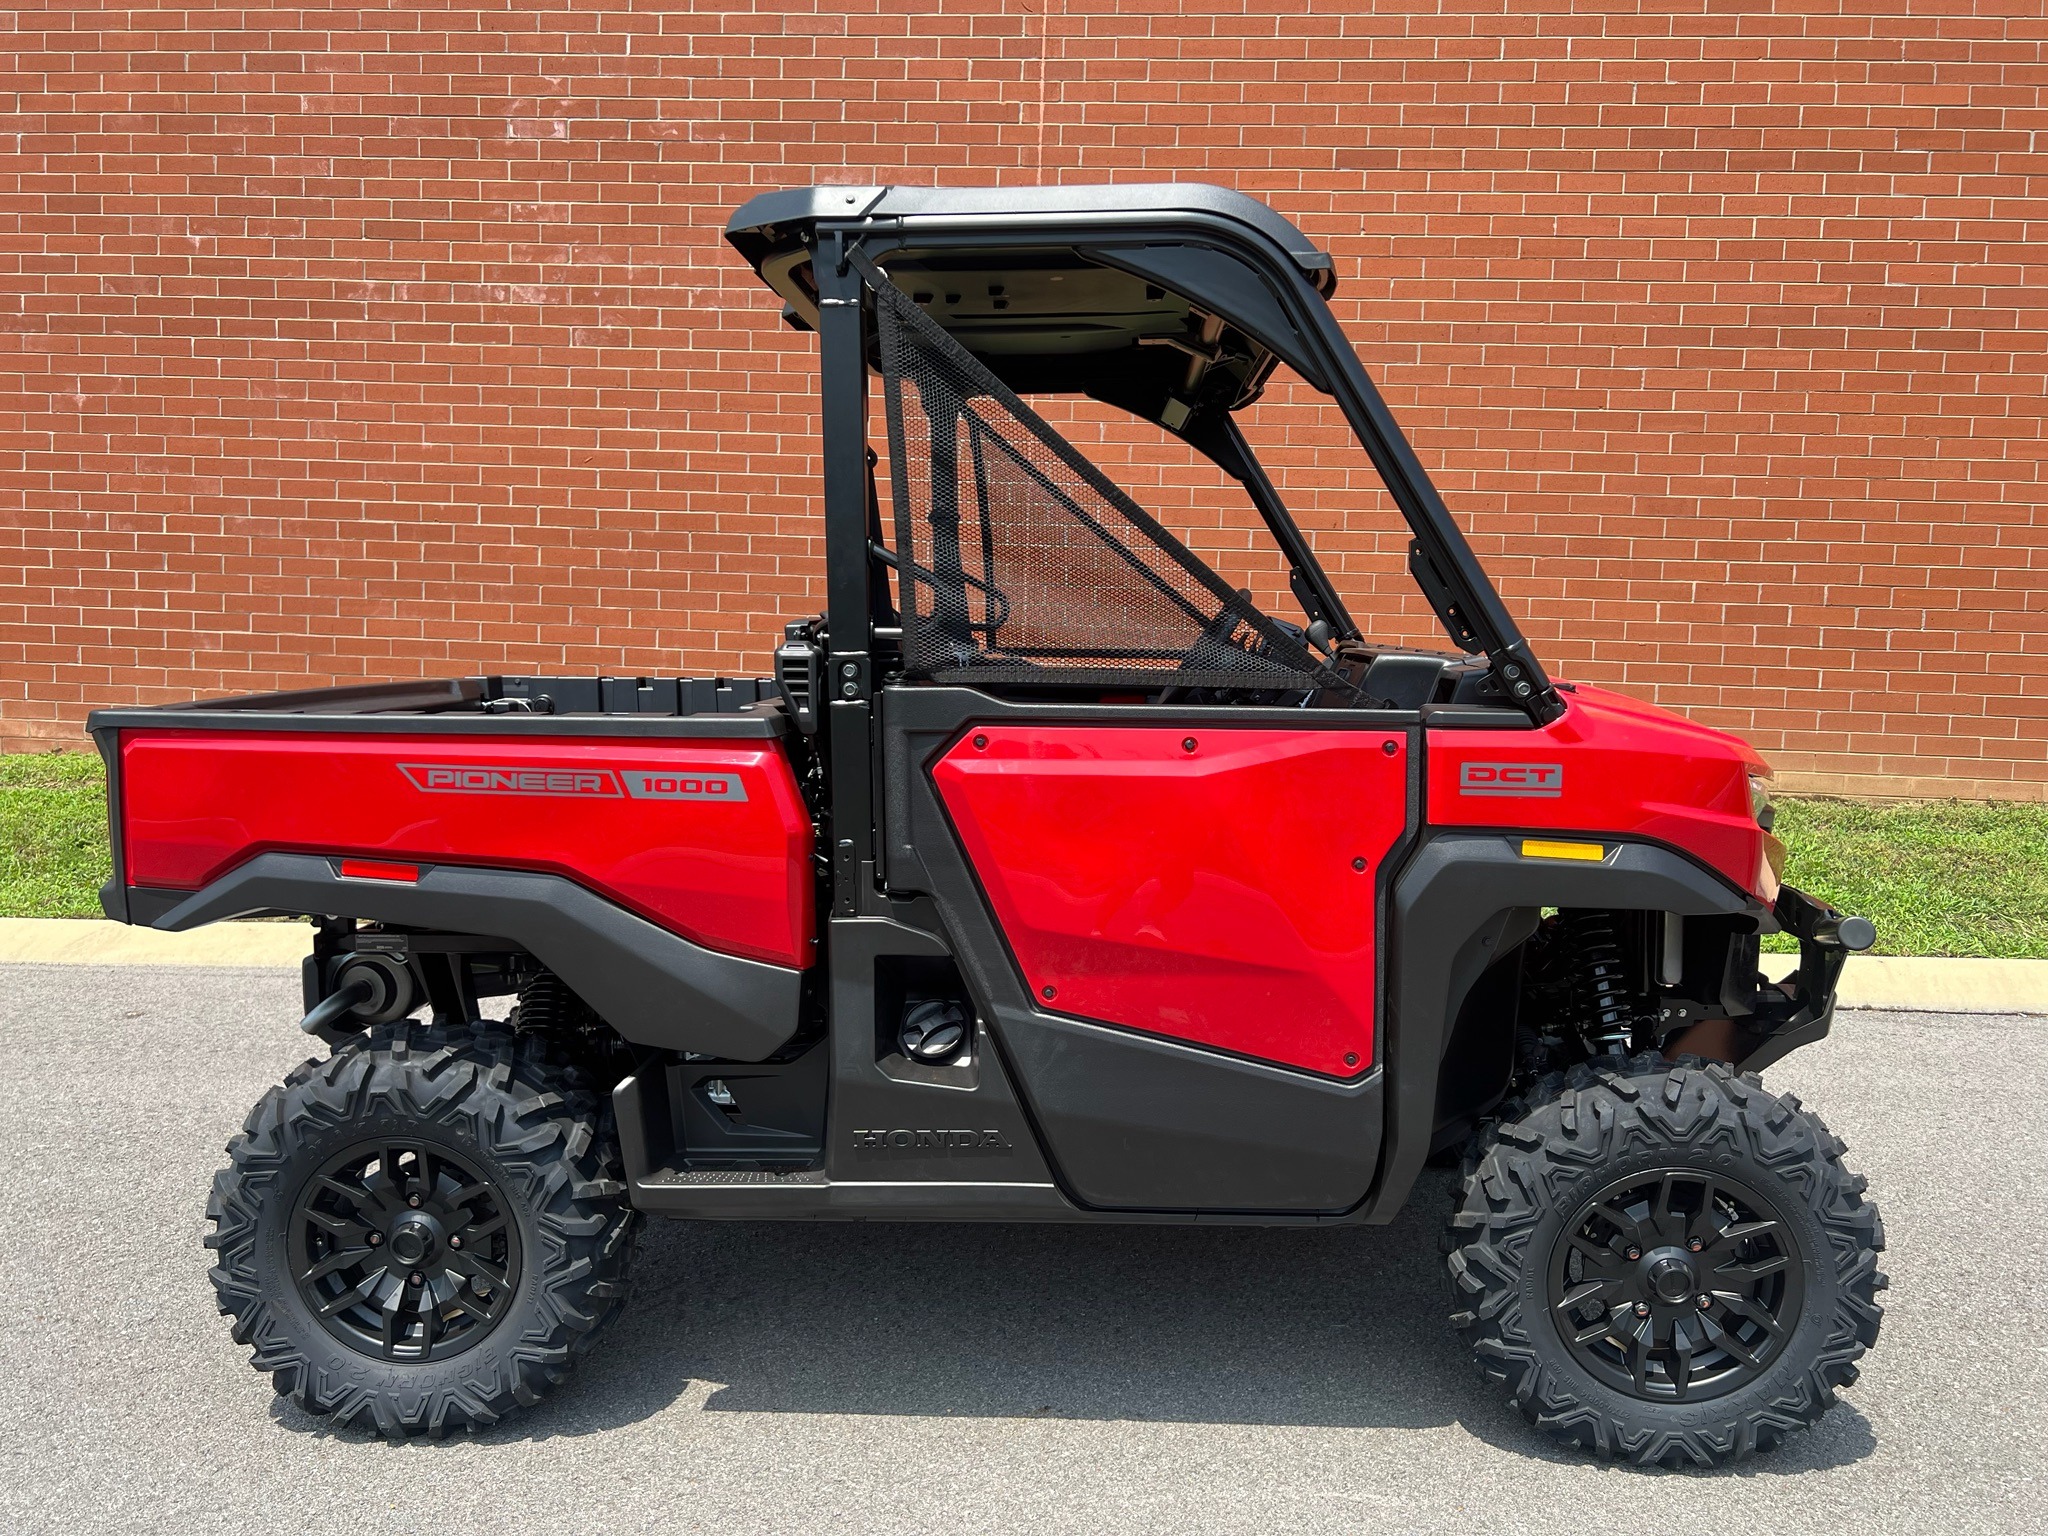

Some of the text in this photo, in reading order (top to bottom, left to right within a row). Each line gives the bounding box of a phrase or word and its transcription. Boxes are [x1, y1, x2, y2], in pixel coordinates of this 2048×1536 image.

[427, 770, 729, 795] PIONEER 1000
[1467, 767, 1556, 783] DCT
[853, 1129, 1013, 1149] HONDA
[1553, 1146, 1737, 1222] BIGHORN 2.0
[326, 1346, 498, 1390] BIGHORN 2.0
[1678, 1363, 1797, 1428] MAXXIS
